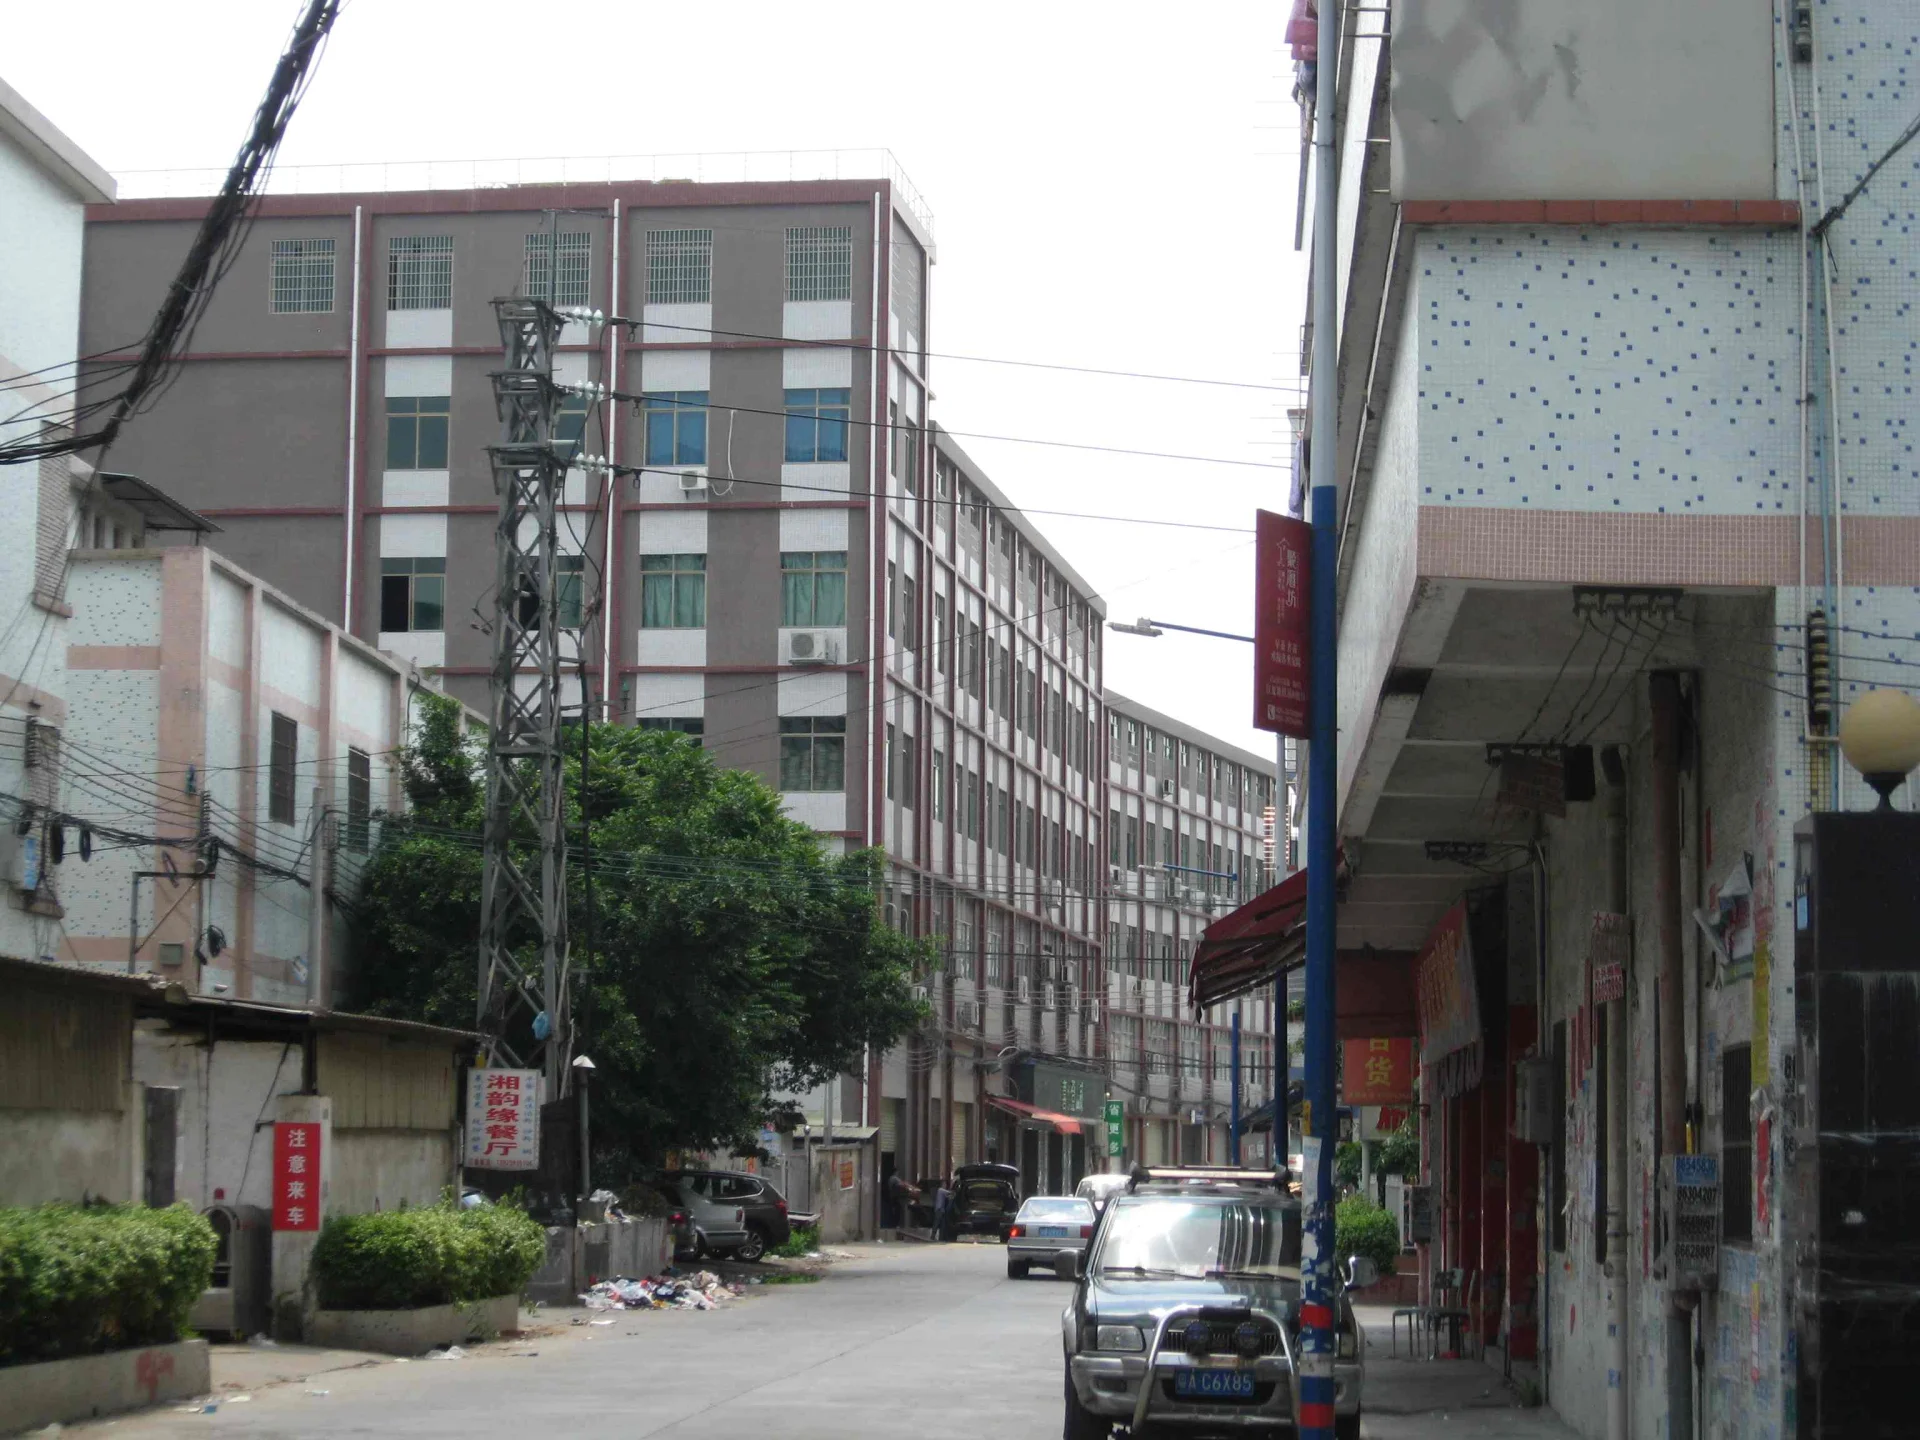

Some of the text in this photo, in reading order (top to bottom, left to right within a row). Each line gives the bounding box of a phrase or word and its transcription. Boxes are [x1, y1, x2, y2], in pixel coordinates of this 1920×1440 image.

[483, 1074, 521, 1156] 湘韵缘餐厅
[287, 1128, 307, 1225] 注意来车
